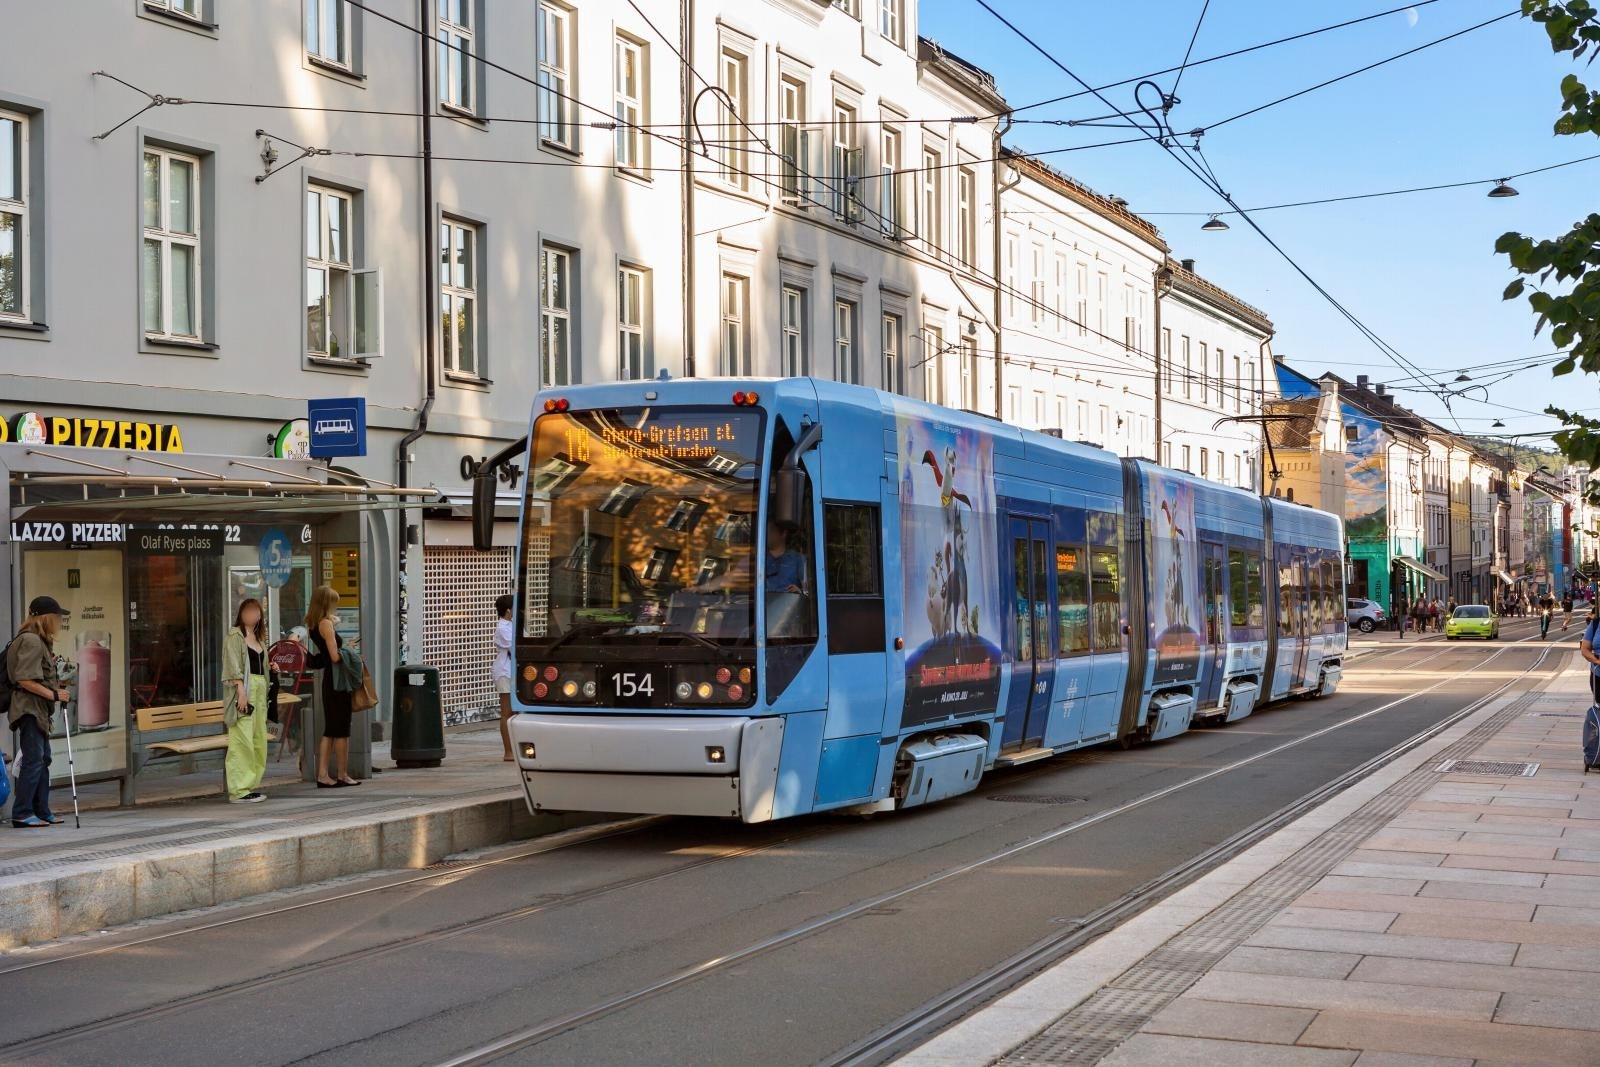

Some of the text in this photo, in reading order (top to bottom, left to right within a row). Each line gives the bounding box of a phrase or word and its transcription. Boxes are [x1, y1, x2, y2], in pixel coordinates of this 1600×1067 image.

[53, 416, 184, 453] PIZZERIA
[10, 523, 66, 542] LAZZO
[225, 525, 241, 542] 22
[141, 535, 211, 552] Olaf Ryes plass
[269, 539, 282, 566] 5
[612, 673, 654, 697] 154
